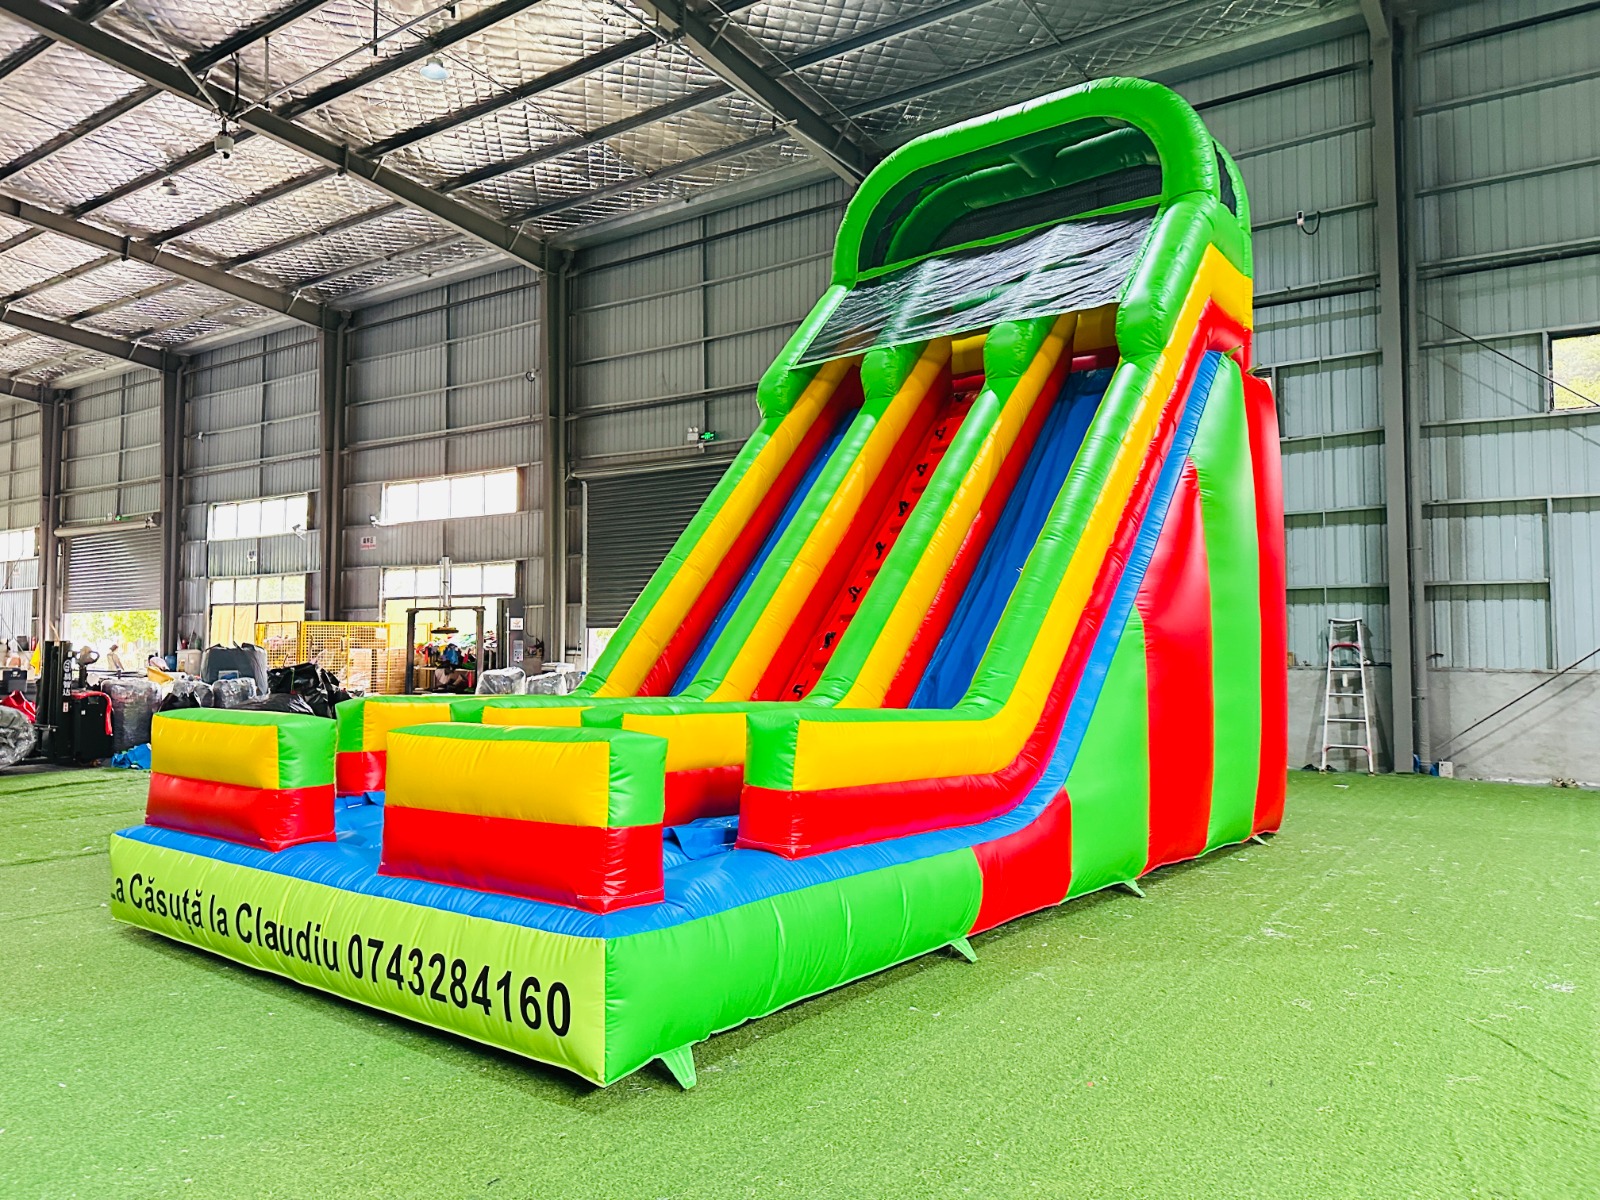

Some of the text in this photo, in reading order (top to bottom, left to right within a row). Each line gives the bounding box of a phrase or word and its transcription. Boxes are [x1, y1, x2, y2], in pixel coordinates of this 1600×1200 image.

[111, 877, 126, 904] a
[209, 894, 231, 938] la
[235, 902, 341, 973] Claudiu
[347, 933, 572, 1037] 0743284160
